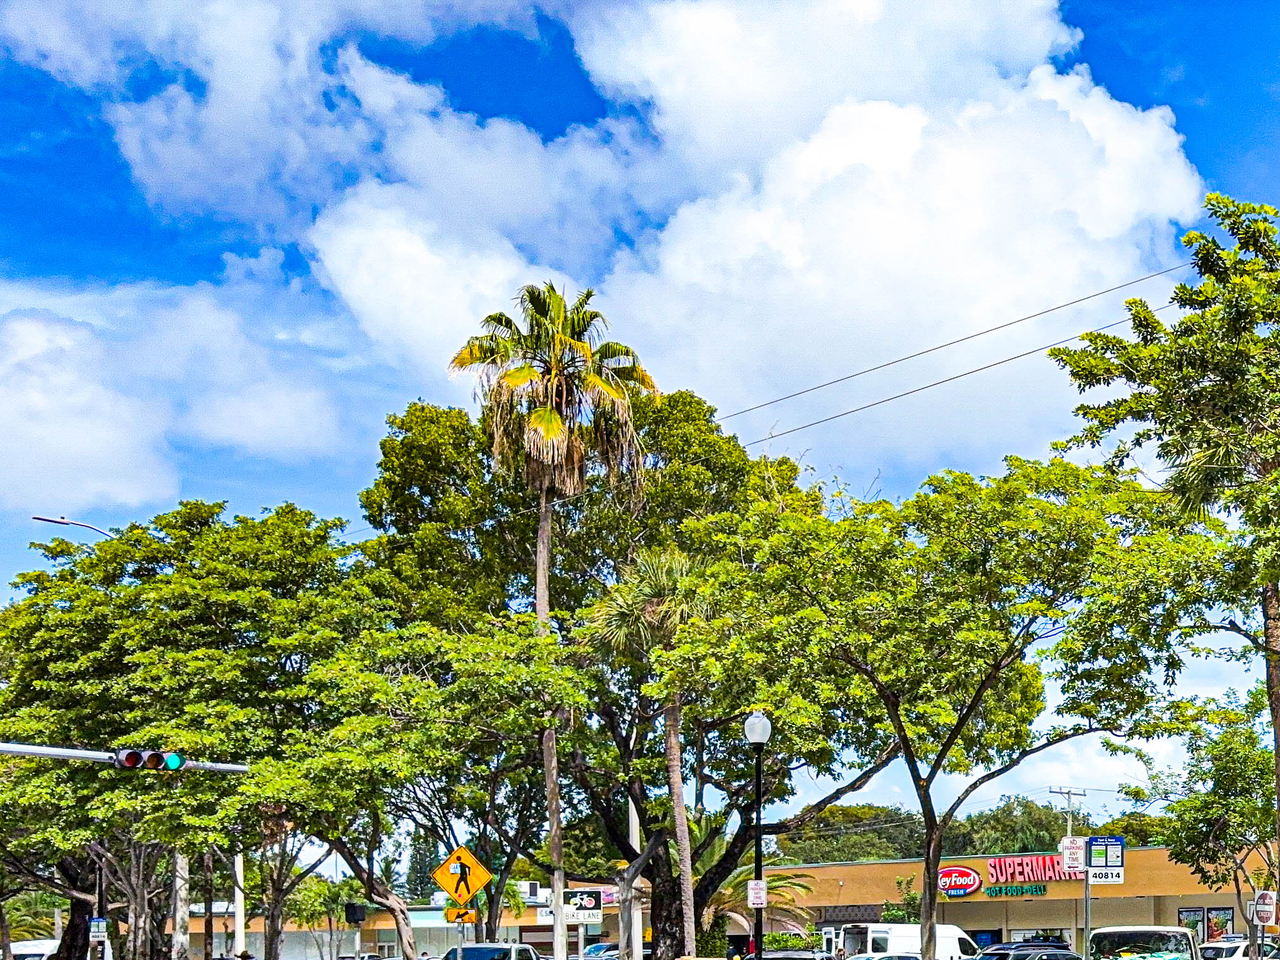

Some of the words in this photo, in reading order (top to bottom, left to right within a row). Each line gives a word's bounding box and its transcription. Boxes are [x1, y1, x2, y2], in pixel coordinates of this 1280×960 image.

[985, 886, 1000, 897] HOT
[1001, 886, 1022, 896] FOOD
[565, 912, 579, 920] BIKE
[583, 912, 600, 920] LANE
